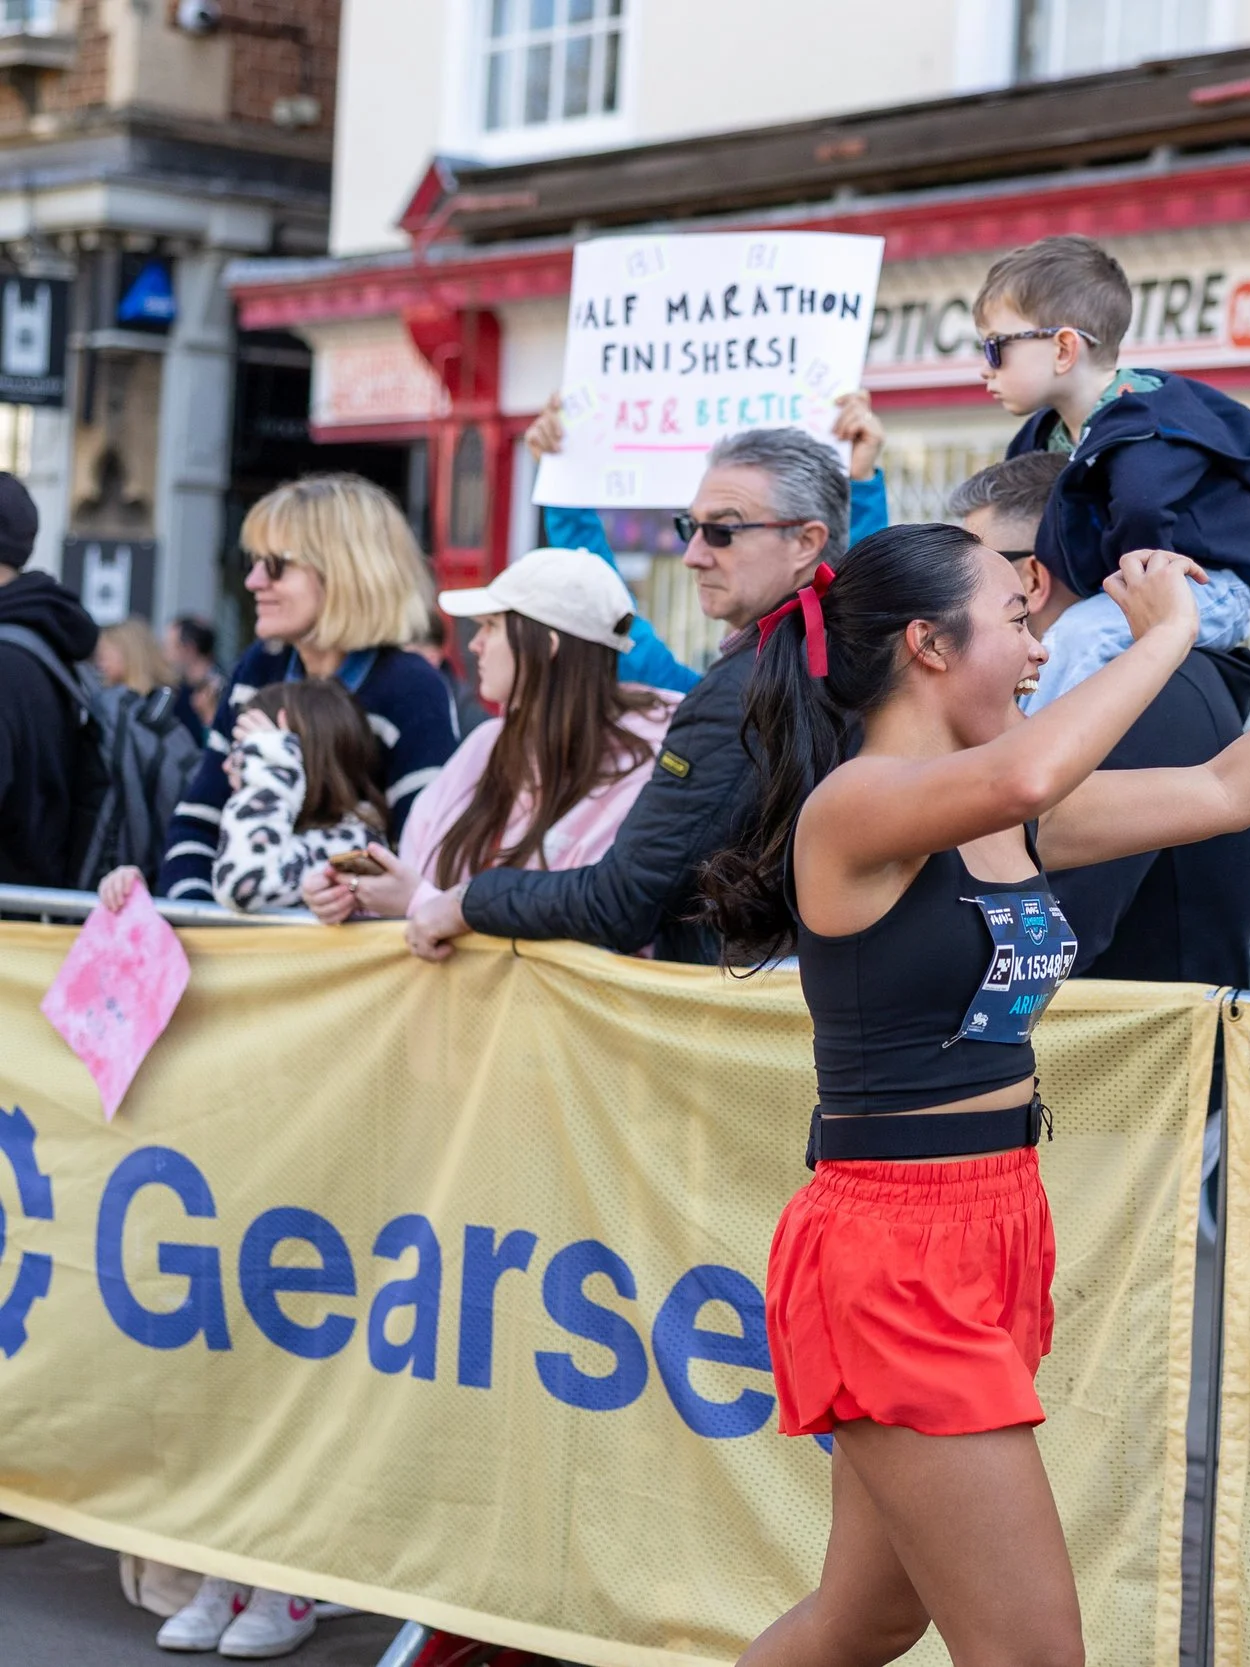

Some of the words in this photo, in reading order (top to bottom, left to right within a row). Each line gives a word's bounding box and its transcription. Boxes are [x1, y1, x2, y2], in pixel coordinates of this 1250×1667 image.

[666, 284, 861, 326] MARATHON
[869, 297, 984, 360] PTIC
[1134, 272, 1224, 343] TRE
[602, 336, 797, 375] FINISHERS!
[695, 393, 803, 428] BERTIE
[1013, 954, 1060, 981] K.15348
[96, 1146, 833, 1456] Gearse
